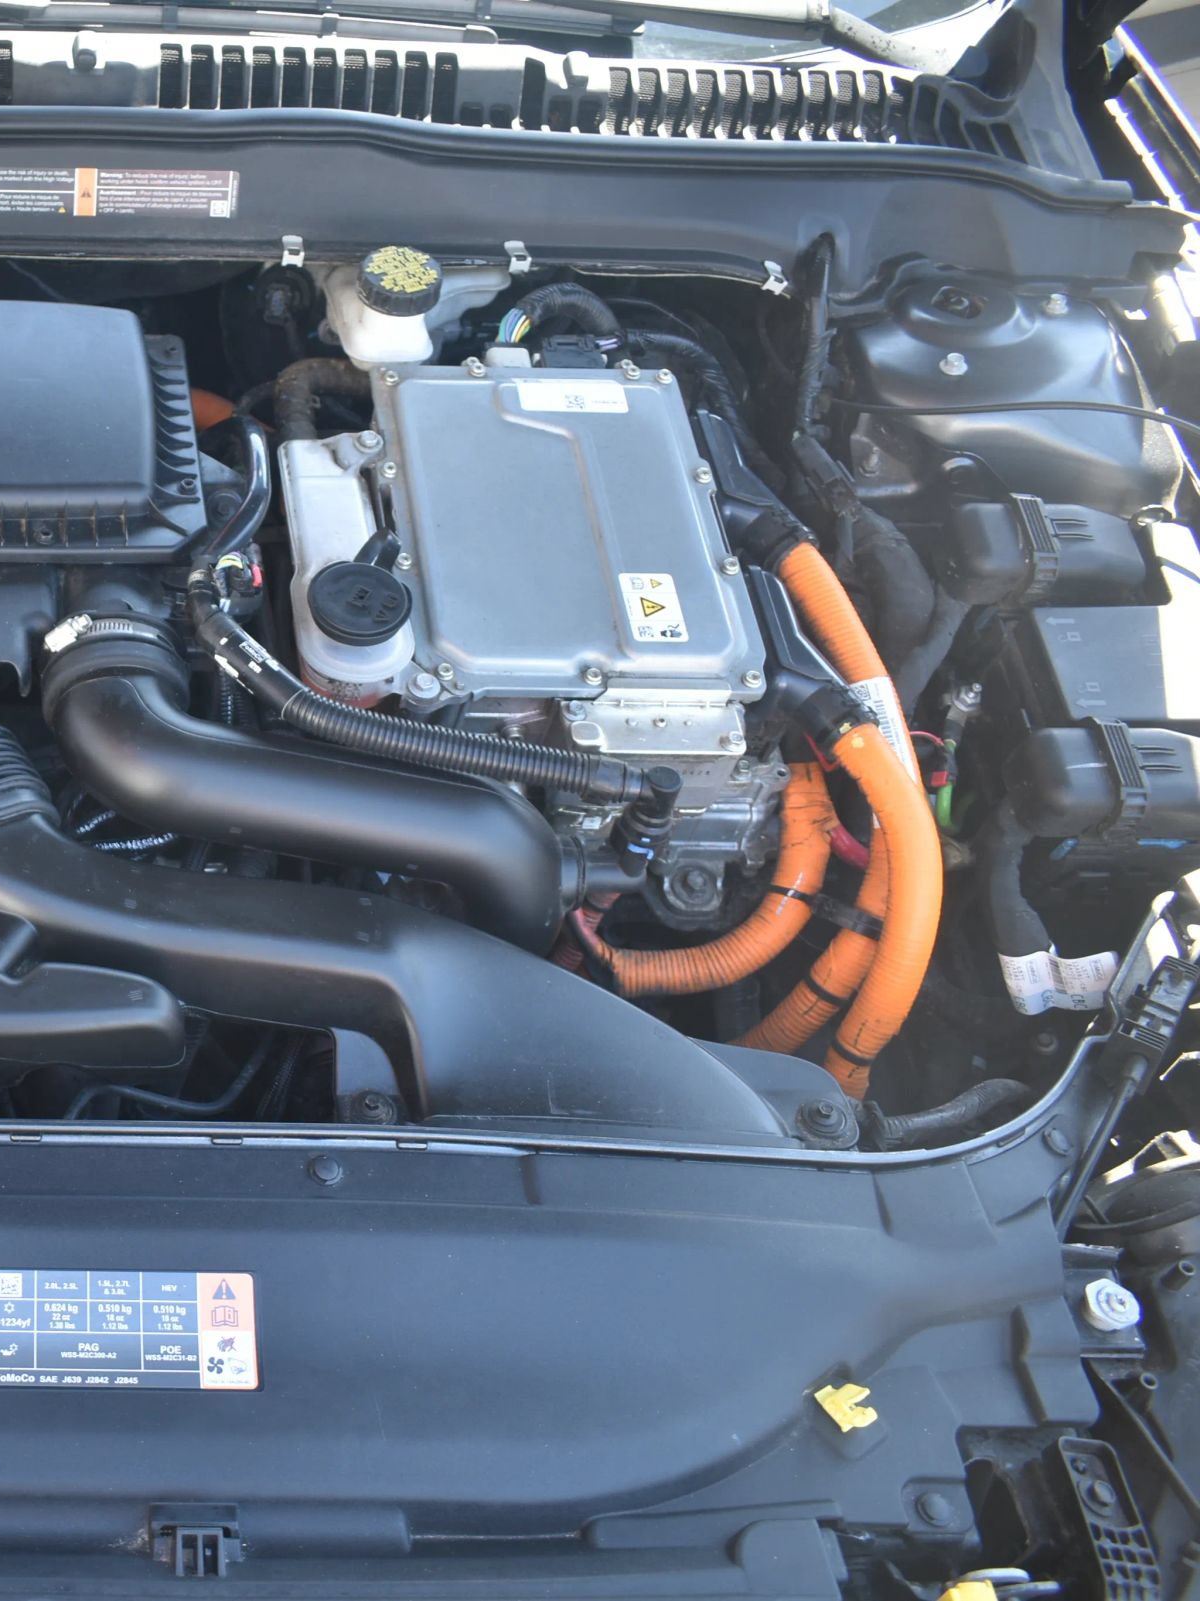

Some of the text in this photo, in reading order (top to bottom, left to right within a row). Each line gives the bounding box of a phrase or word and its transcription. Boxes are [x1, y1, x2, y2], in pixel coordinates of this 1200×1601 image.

[162, 1284, 178, 1292] HEV
[44, 1303, 78, 1314] 0.624 kg
[98, 1304, 132, 1315] 0.510 kg
[153, 1305, 186, 1316] 0.510 kg
[78, 1343, 99, 1351] PAG
[160, 1346, 181, 1354] POE
[85, 1376, 109, 1384] J2842
